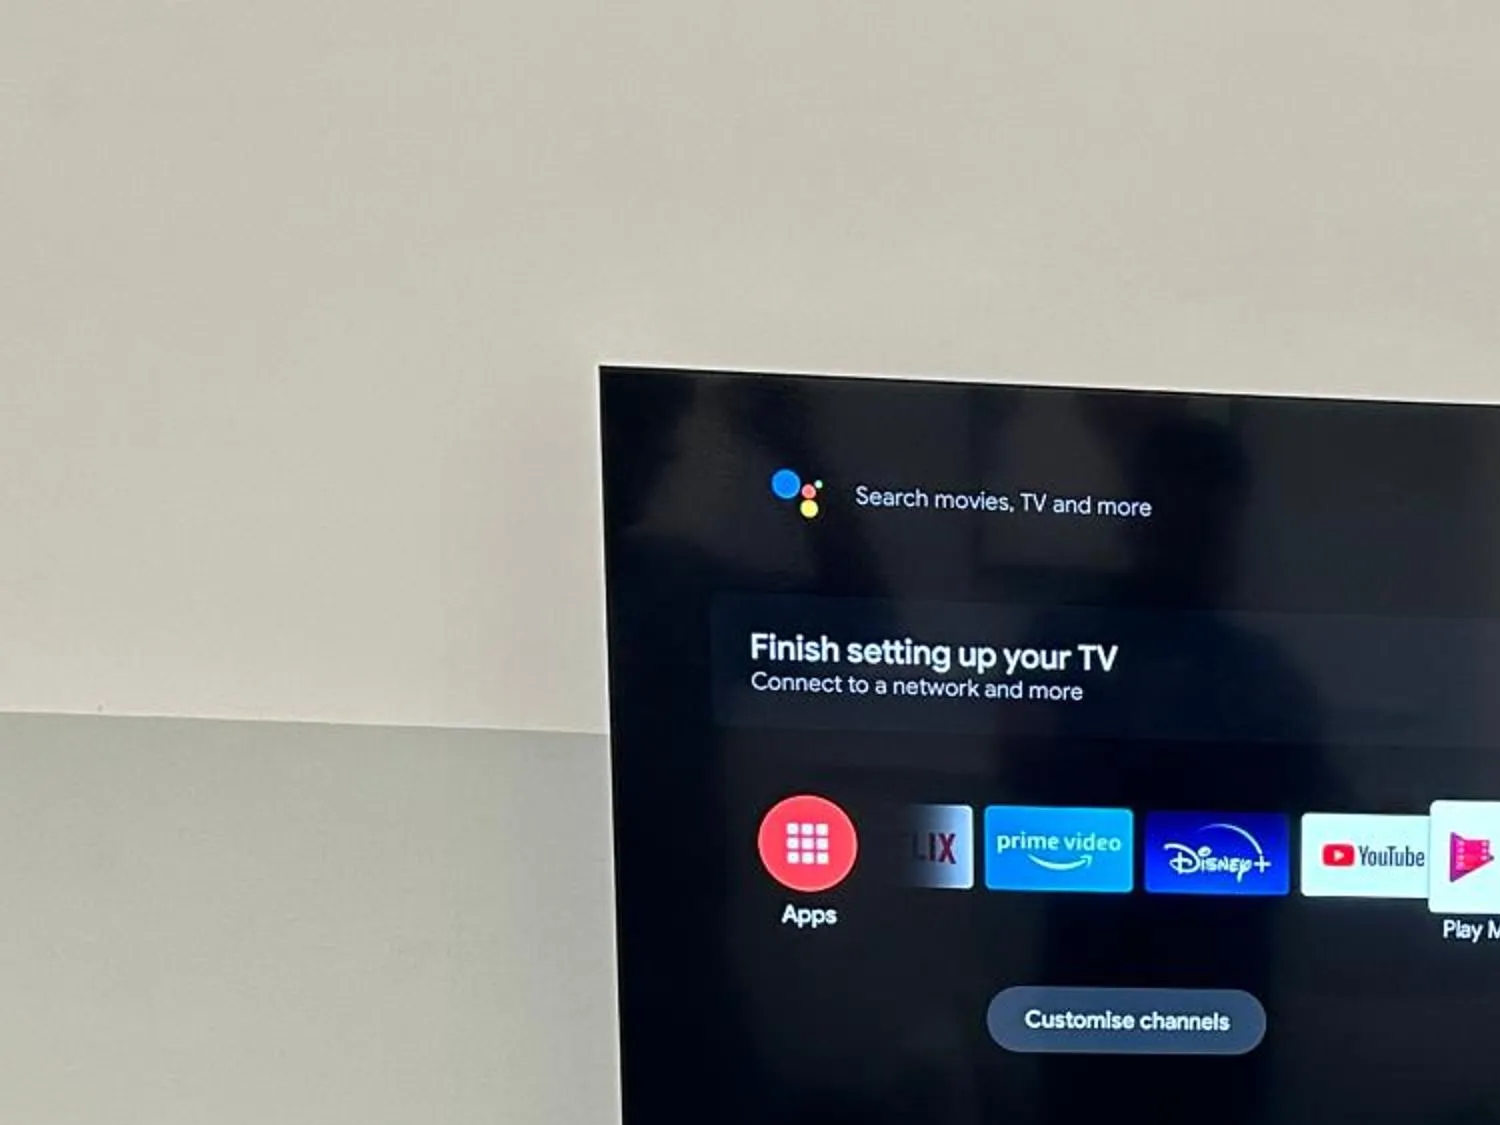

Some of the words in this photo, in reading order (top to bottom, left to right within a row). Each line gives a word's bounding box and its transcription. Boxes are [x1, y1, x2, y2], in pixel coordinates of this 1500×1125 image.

[856, 486, 928, 507] Search
[935, 492, 1014, 512] movies,
[1020, 493, 1046, 512] TV
[1053, 496, 1091, 514] and
[1098, 501, 1152, 516] more
[752, 633, 839, 662] Finish
[848, 638, 950, 673] setting
[959, 647, 996, 674] up
[1003, 648, 1072, 675] your
[1078, 645, 1118, 671] TV
[752, 672, 842, 692] Connect
[848, 676, 868, 694] to
[875, 680, 887, 694] a
[894, 679, 979, 696] network
[985, 681, 1022, 698] and
[1029, 685, 1083, 700] more
[997, 832, 1059, 853] prime
[1064, 832, 1122, 852] video
[1359, 846, 1424, 867] YouTube
[782, 904, 837, 928] Apps
[1444, 920, 1483, 943] Play
[1025, 1010, 1134, 1029] Customise
[1140, 1012, 1230, 1030] channels
